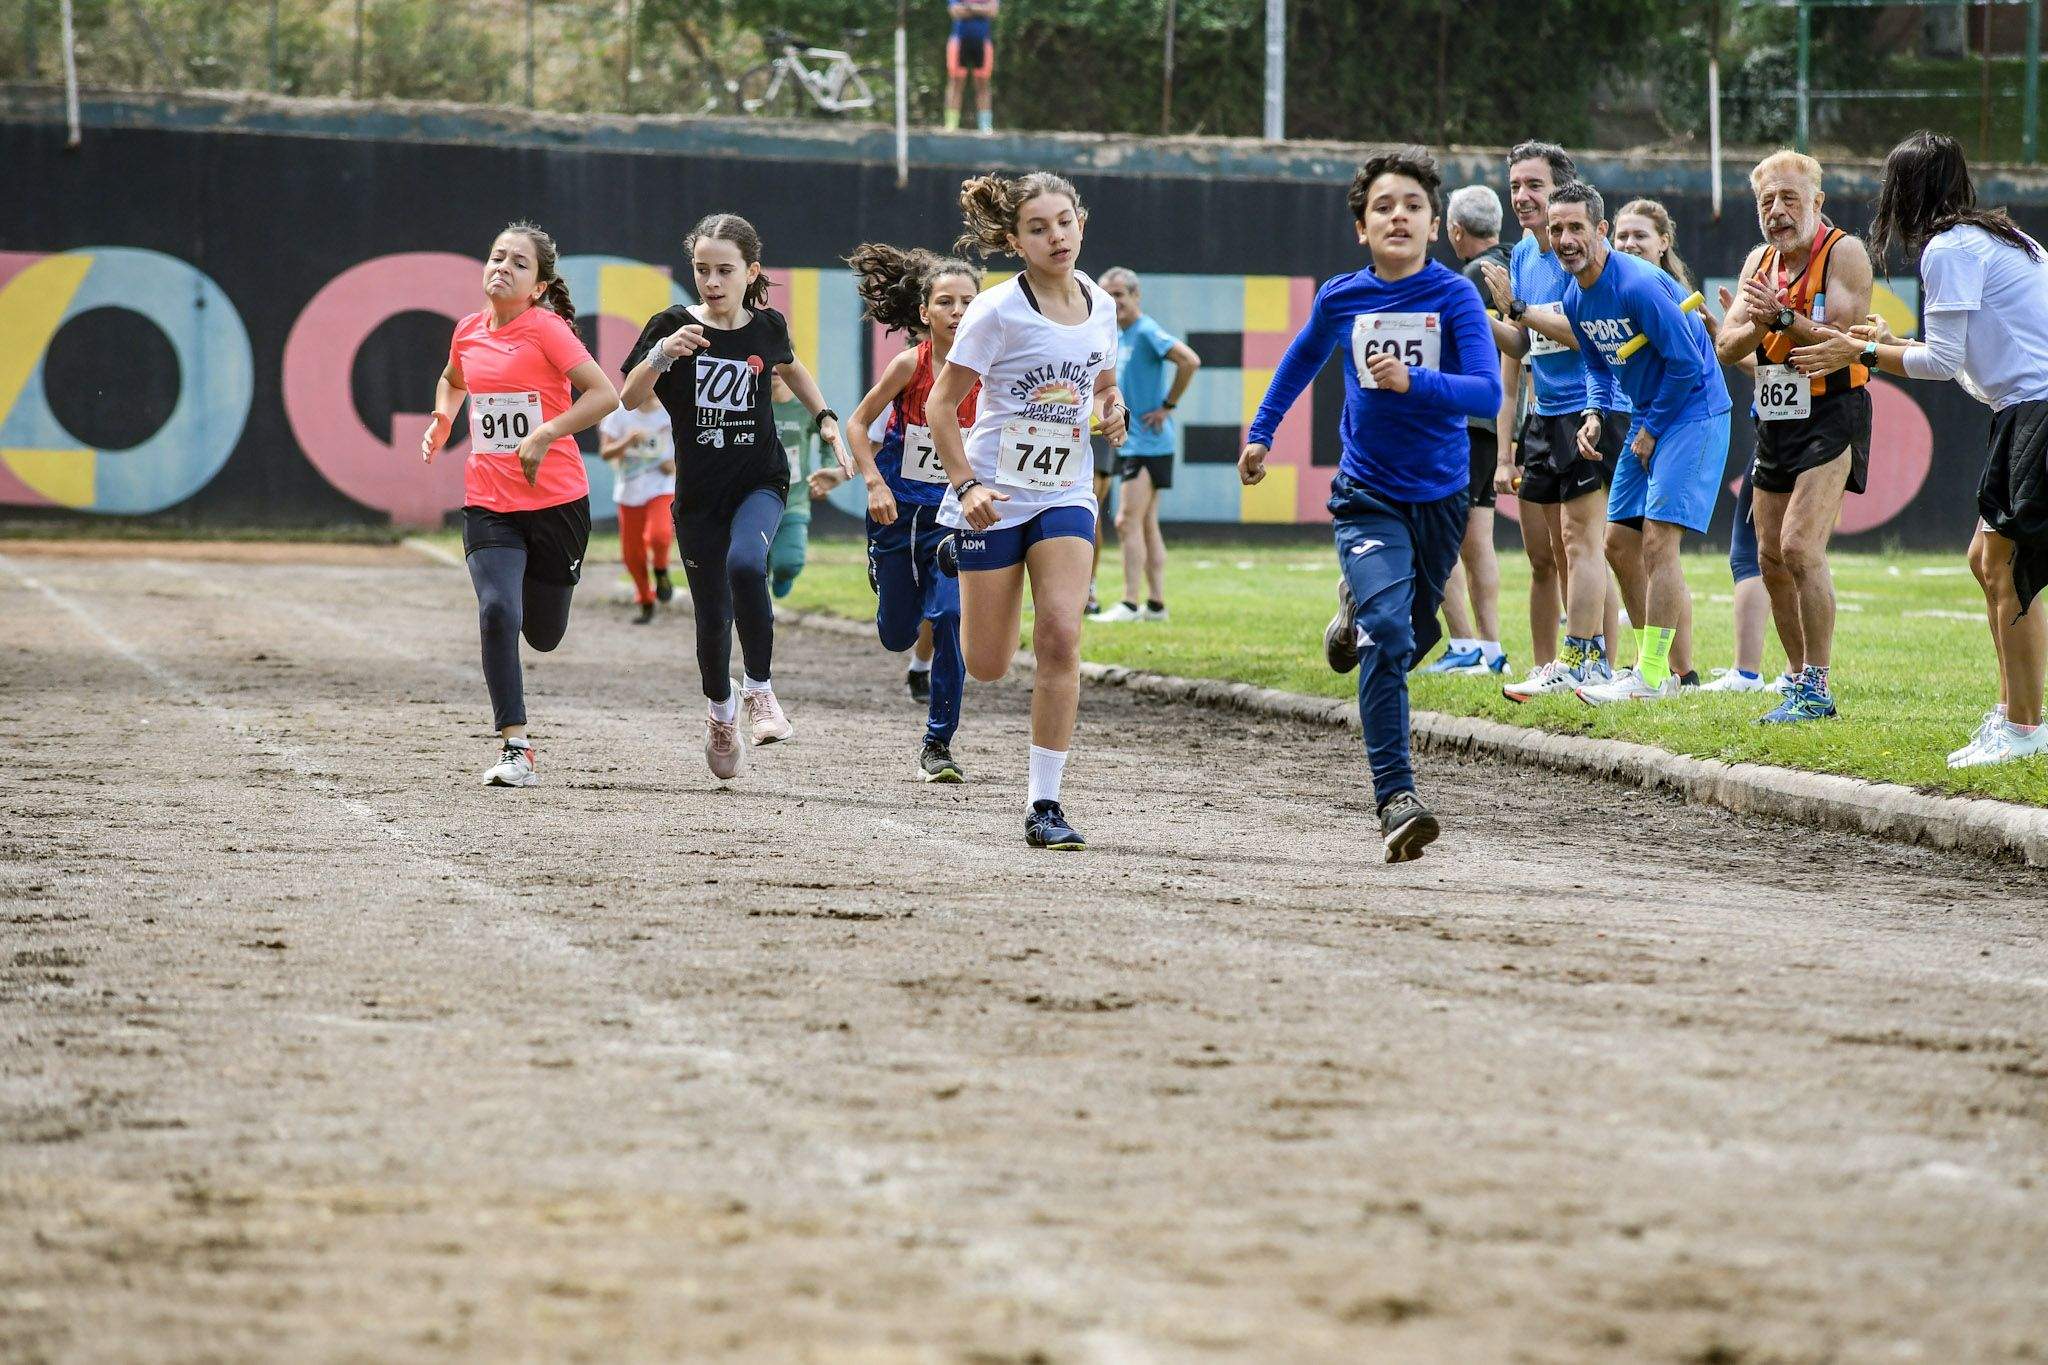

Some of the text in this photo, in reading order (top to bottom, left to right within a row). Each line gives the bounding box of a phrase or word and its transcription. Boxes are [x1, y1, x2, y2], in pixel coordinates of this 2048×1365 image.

[1580, 318, 1634, 340] SPORT
[1011, 363, 1055, 400] SANTA
[1760, 382, 1798, 407] 862
[1023, 402, 1055, 414] TRACK
[481, 411, 529, 439] 910
[701, 417, 712, 425] 31
[1015, 442, 1071, 476] 747
[961, 539, 986, 550] ADM
